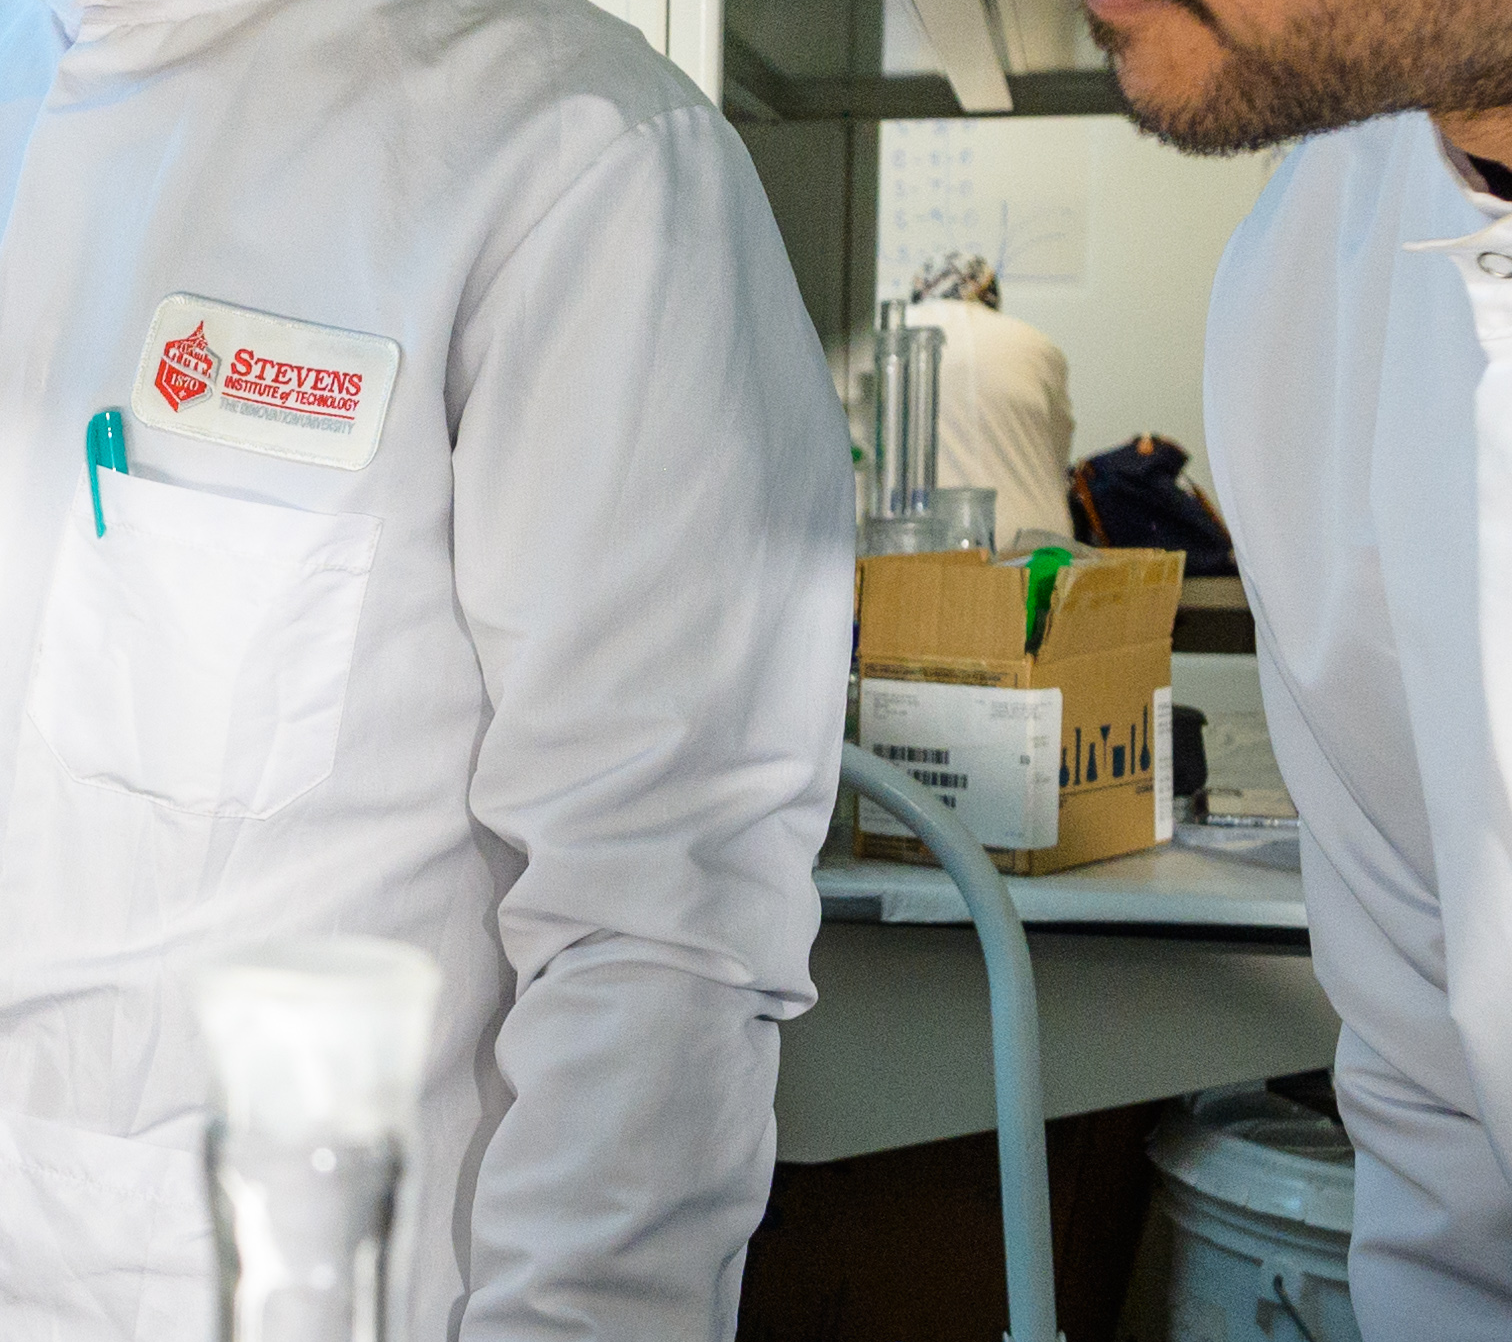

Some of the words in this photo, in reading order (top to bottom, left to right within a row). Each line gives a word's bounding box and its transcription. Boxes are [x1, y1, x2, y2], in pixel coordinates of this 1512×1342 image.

[170, 370, 199, 393] 1870
[231, 348, 363, 397] STEVENS
[224, 375, 280, 400] INSTITUTE
[279, 389, 296, 406] of
[295, 390, 360, 413] TECHNOLOGY
